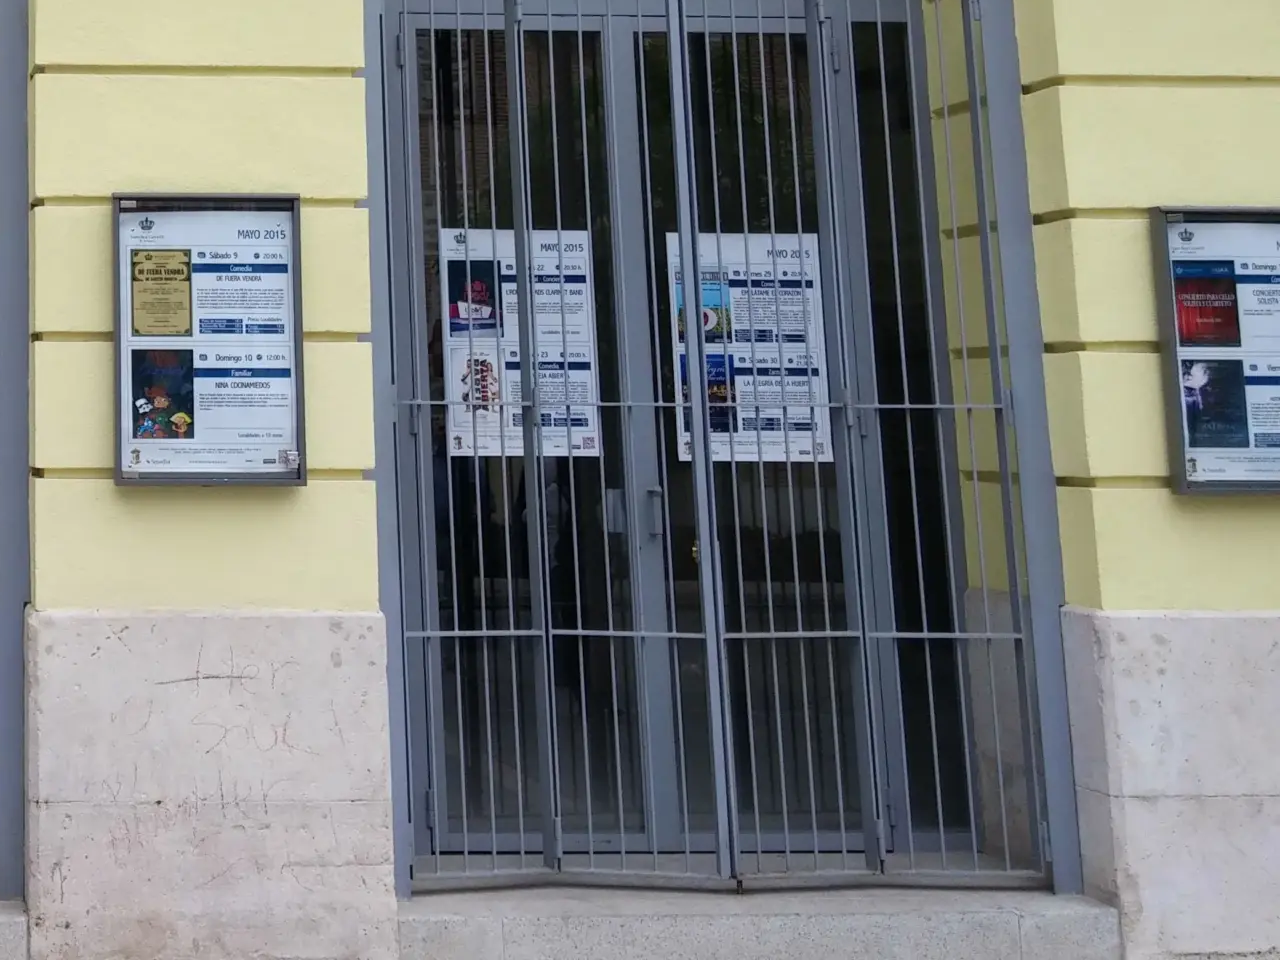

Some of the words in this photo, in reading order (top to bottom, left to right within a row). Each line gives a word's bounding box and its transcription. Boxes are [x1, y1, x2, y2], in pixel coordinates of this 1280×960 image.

[237, 229, 260, 239] MAYO
[263, 230, 286, 240] 2015
[564, 243, 584, 252] 2015
[790, 250, 810, 258] 205
[215, 354, 242, 363] Domingo
